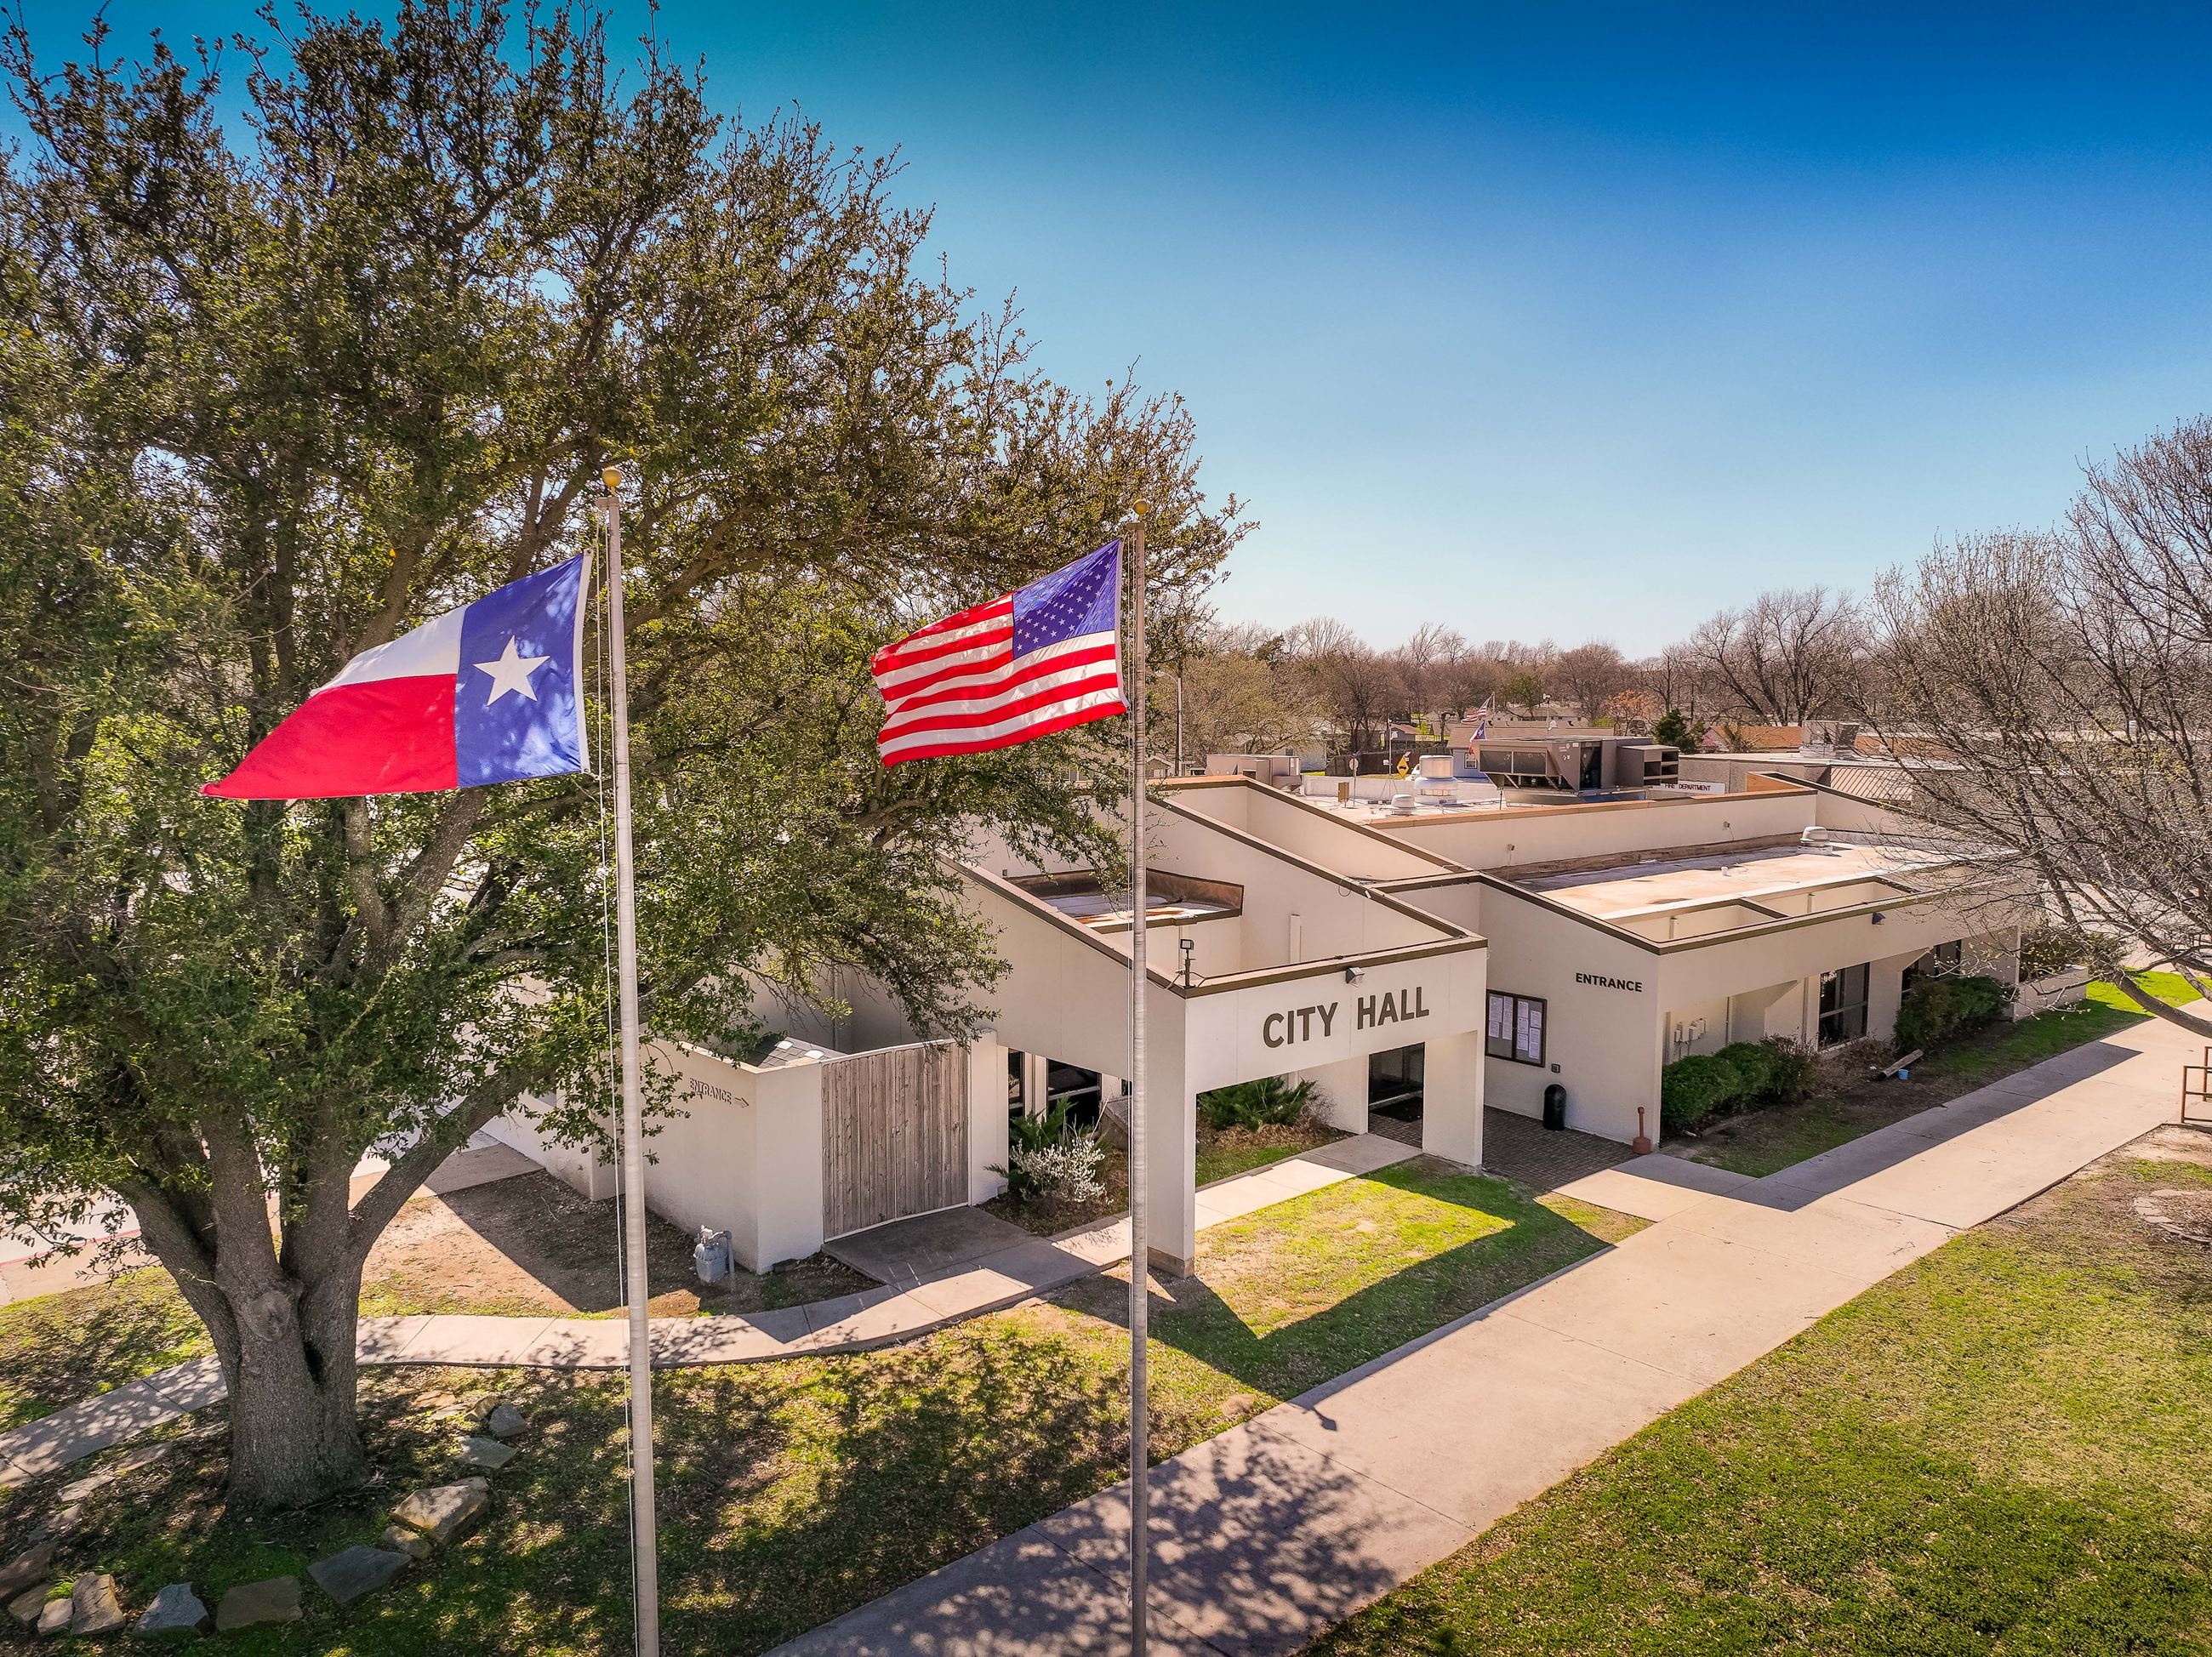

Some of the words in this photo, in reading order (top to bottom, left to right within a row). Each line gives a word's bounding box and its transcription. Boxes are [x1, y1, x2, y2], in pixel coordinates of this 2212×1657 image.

[1576, 972, 1643, 992] ENTRANCE
[1263, 1002, 1338, 1048] CITY
[1357, 987, 1429, 1030] HALL
[689, 1078, 732, 1104] ENTRANCE
